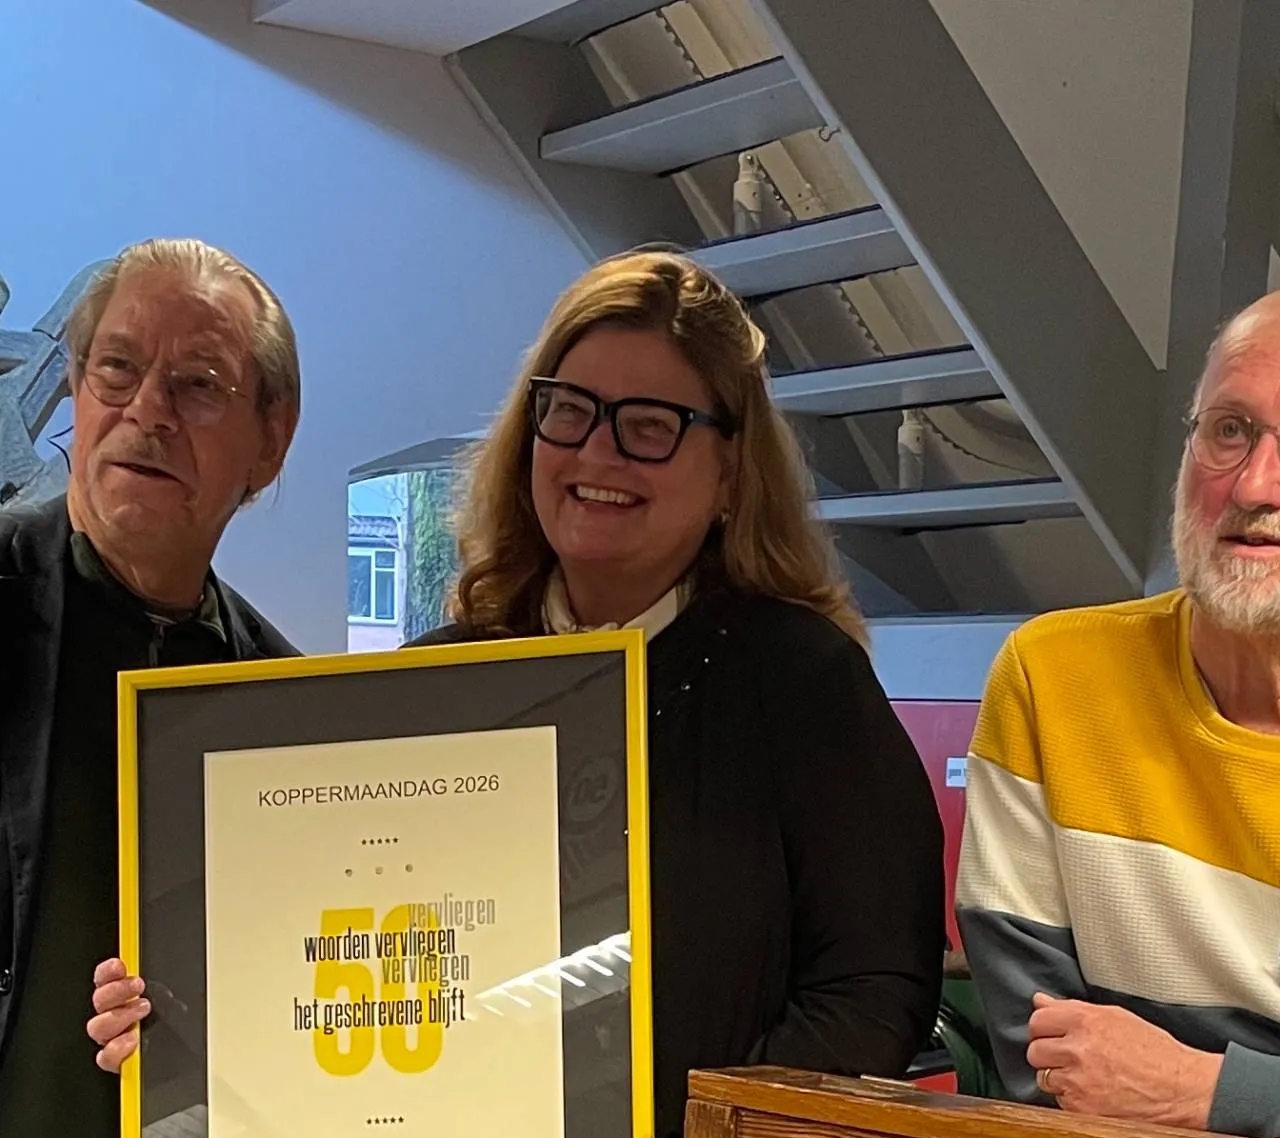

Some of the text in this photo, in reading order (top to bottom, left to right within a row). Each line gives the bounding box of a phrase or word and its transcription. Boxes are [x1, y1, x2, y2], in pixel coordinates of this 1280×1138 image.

[258, 774, 500, 807] KOPPERMAANDAG 2026
[408, 893, 495, 931] vervliegen
[304, 923, 456, 962] woorden vervliegen
[382, 952, 470, 987] vervliegen
[313, 903, 443, 1077] 50
[294, 987, 465, 1035] het geschrevene blijft
